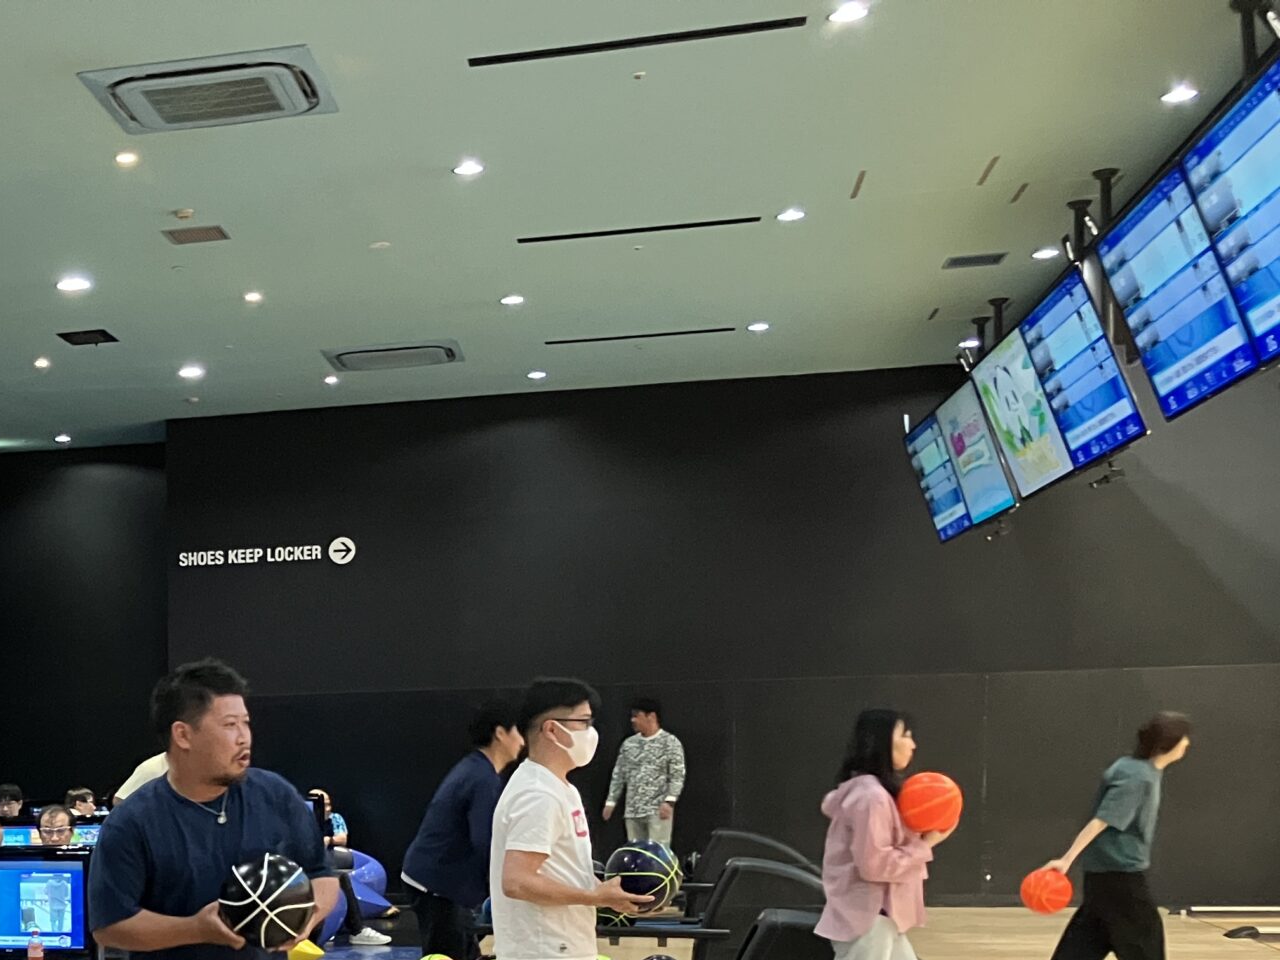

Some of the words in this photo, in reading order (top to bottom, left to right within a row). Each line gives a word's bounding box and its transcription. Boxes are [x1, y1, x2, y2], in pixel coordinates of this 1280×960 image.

[179, 551, 224, 566] SHOES
[228, 549, 263, 563] KEEP
[267, 545, 321, 562] LOCKER
